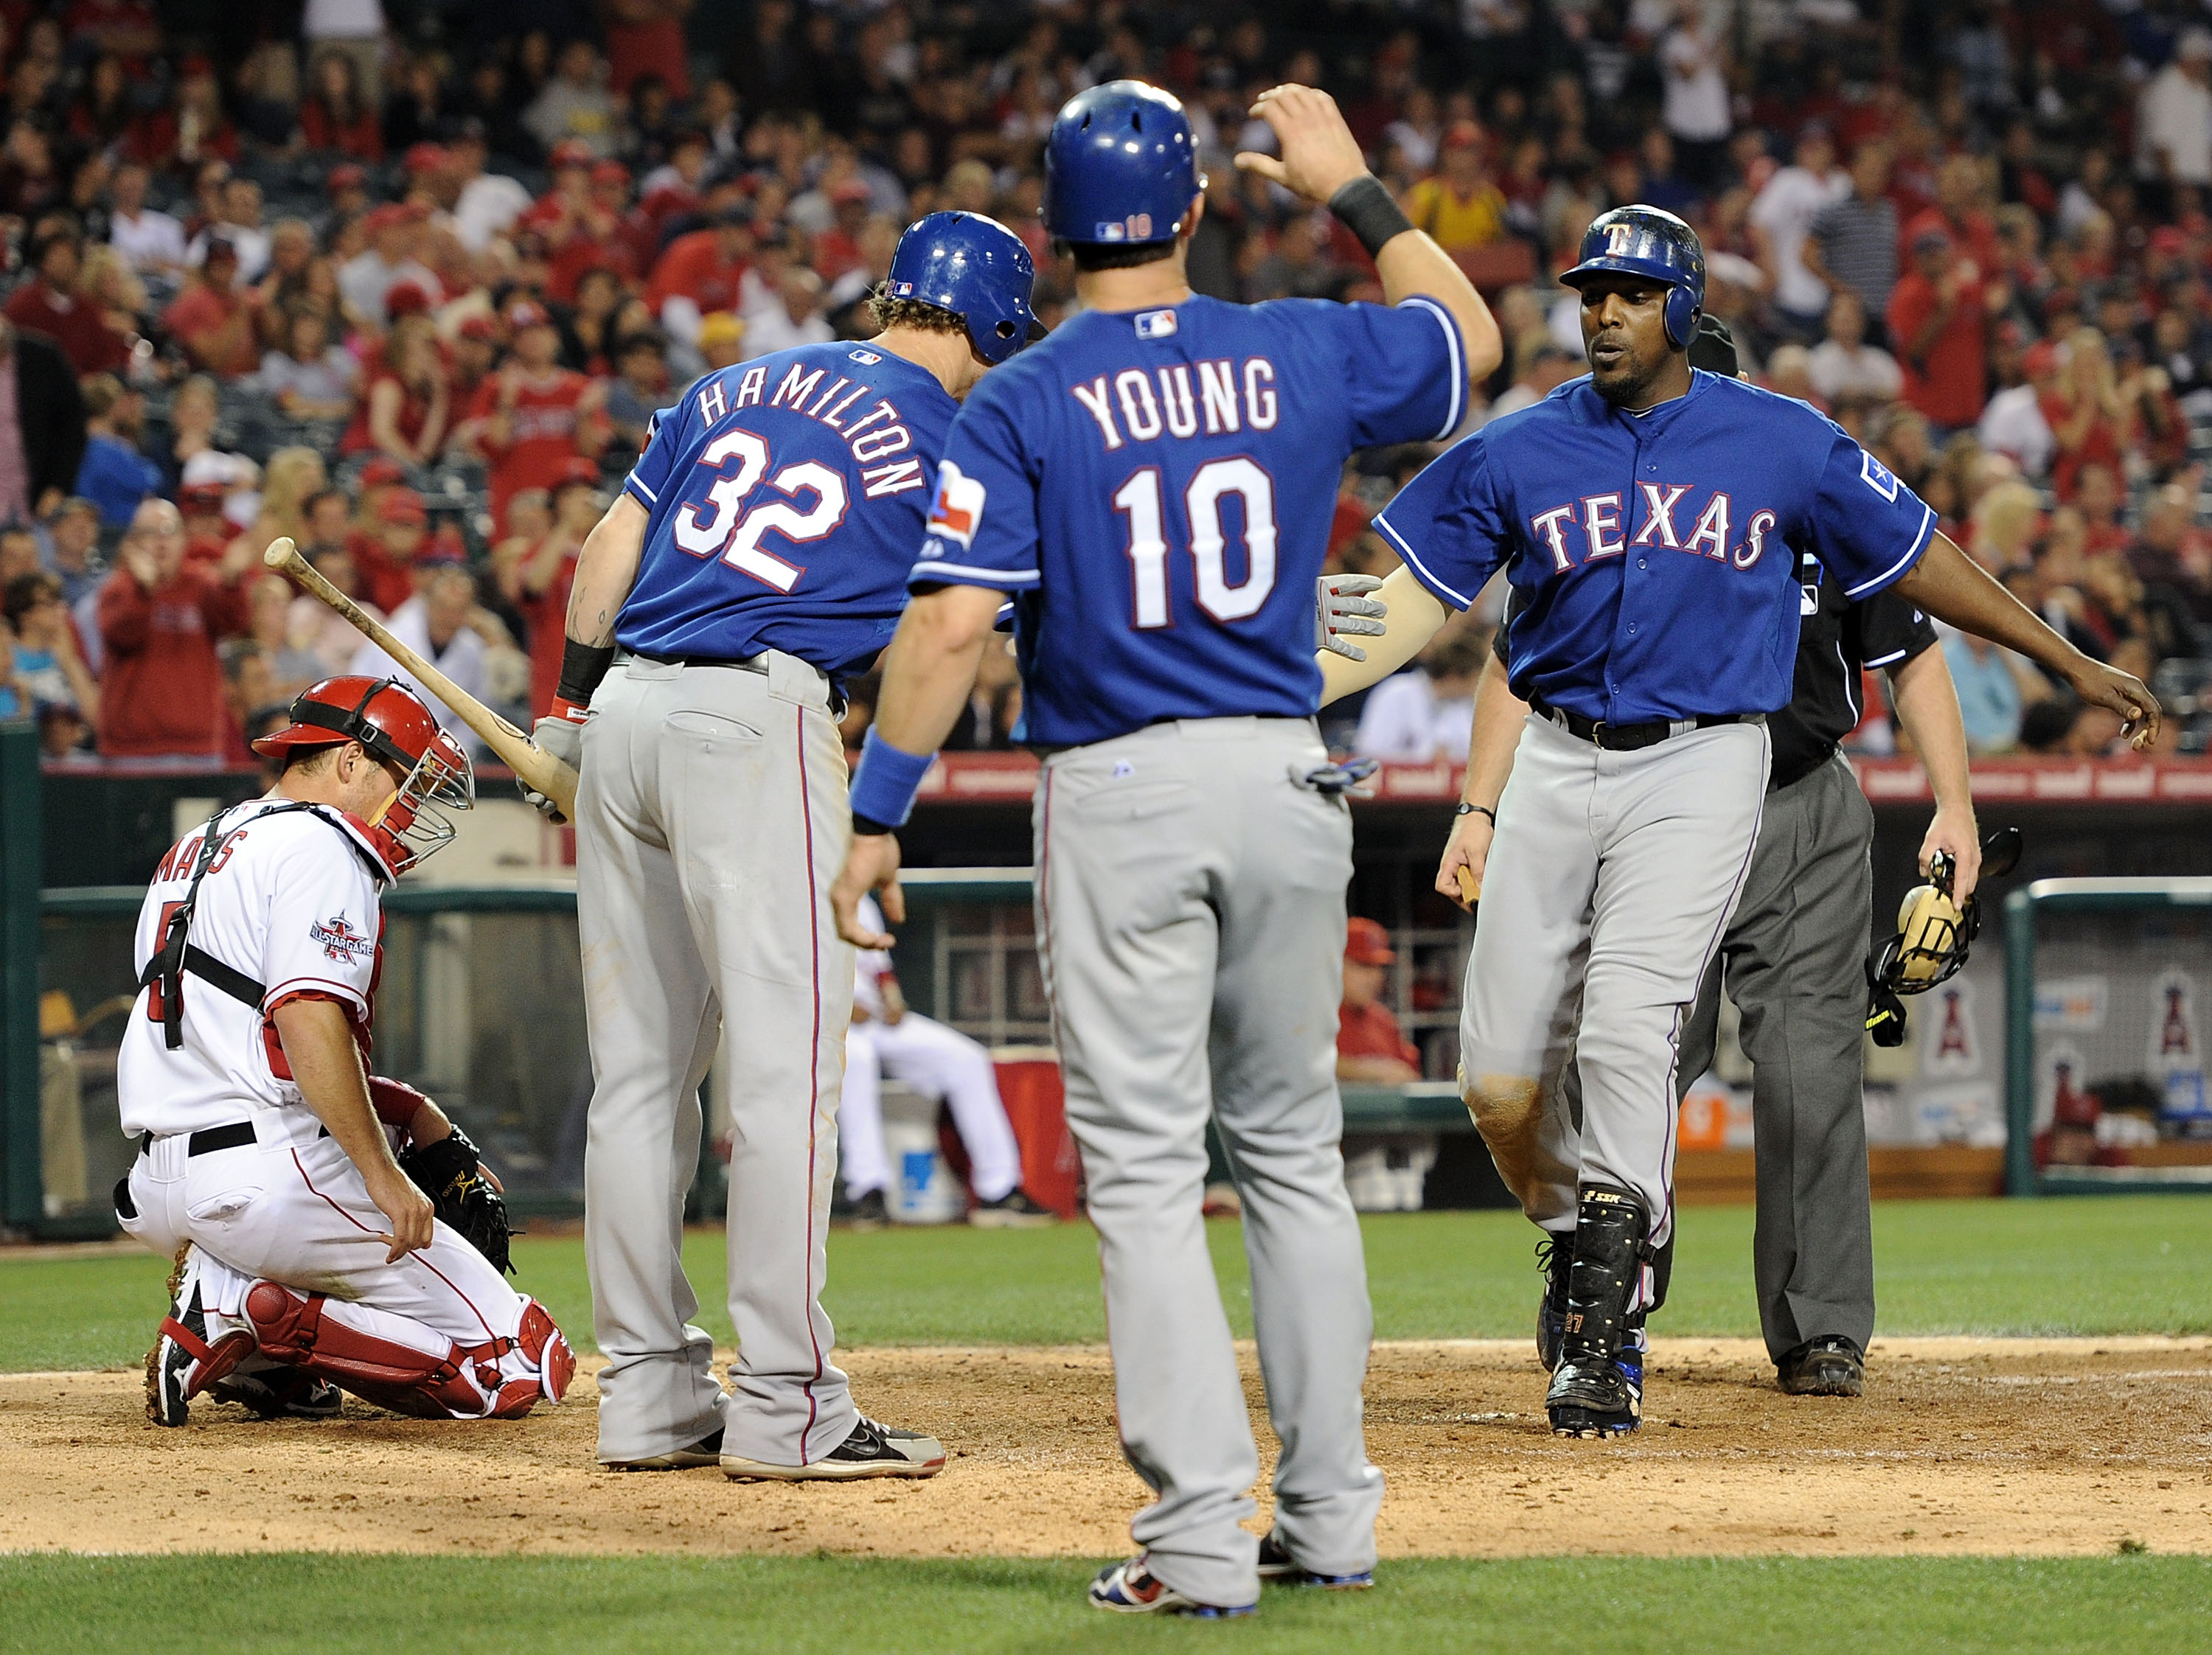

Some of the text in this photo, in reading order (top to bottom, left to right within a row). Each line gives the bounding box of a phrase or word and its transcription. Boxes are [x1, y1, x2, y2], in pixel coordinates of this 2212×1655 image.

[1603, 223, 1632, 257] T
[697, 362, 926, 501] HAMILTON
[1071, 357, 1279, 450] YOUNG
[673, 427, 850, 596] 32
[1113, 454, 1279, 631] 10
[1531, 481, 1776, 575] TEXAS
[346, 939, 373, 957] GAME
[1565, 1312, 1584, 1334] 27
